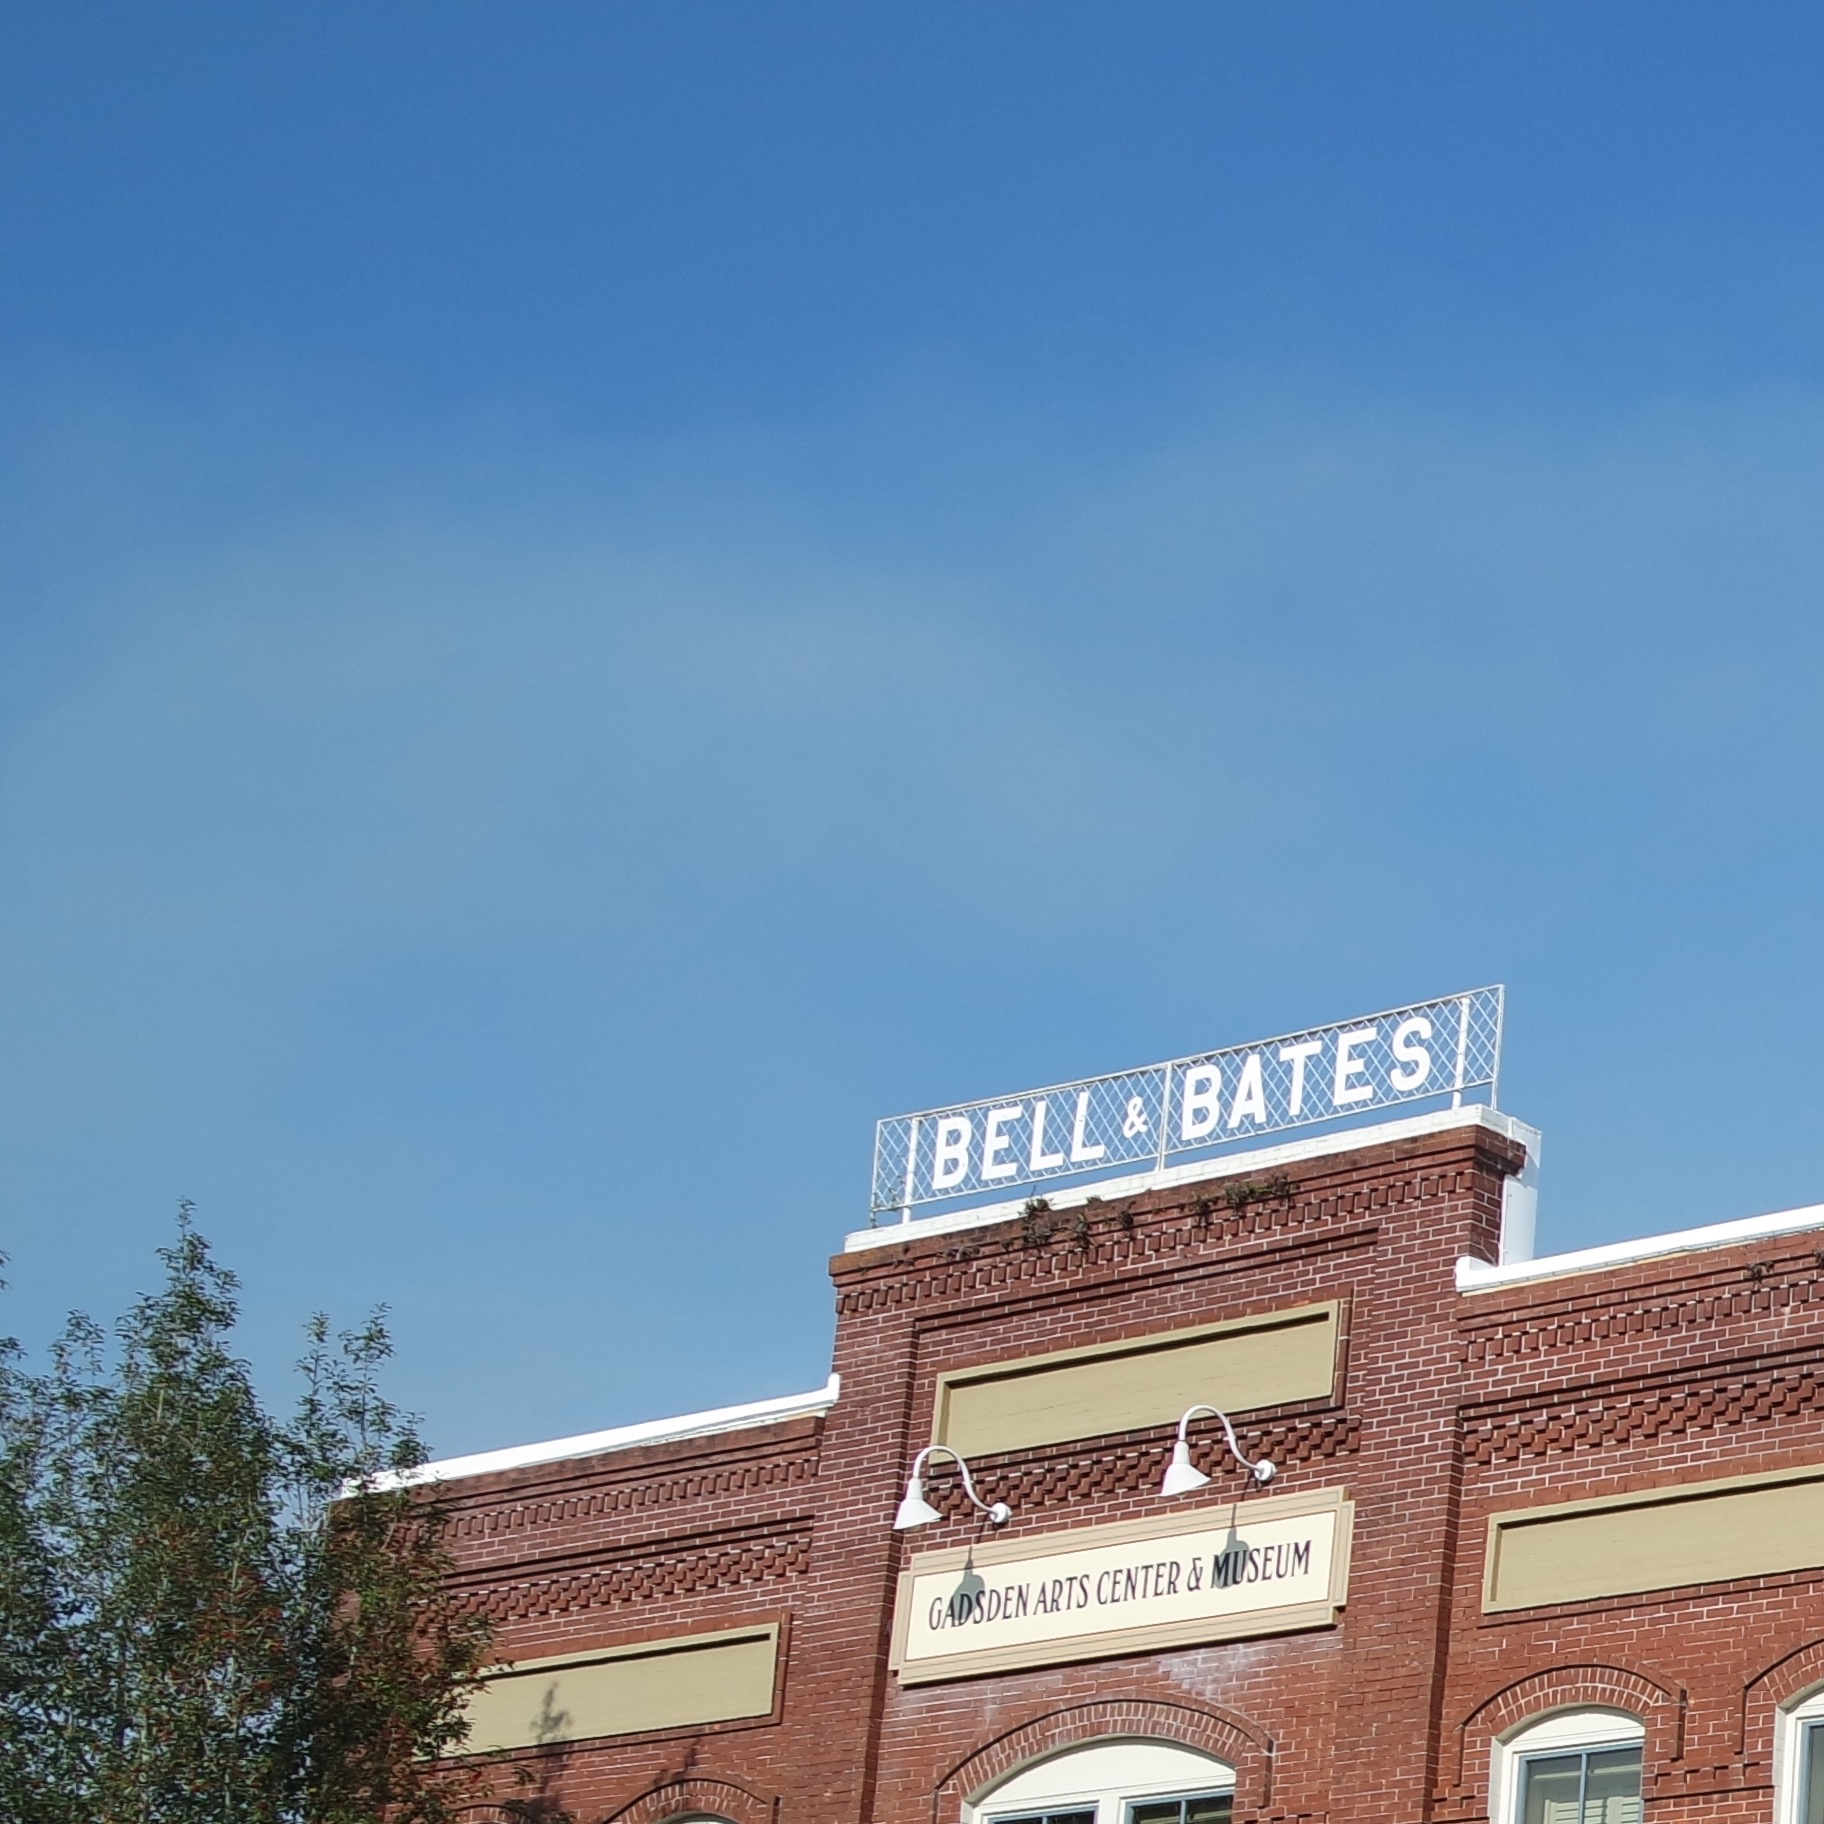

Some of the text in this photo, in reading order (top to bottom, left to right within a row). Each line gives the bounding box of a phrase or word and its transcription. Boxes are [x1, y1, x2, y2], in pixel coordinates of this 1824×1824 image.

[932, 1016, 1433, 1190] BELL & BATES
[928, 1540, 1312, 1631] GADSDEN ARTS CENTER & MUSEUM
